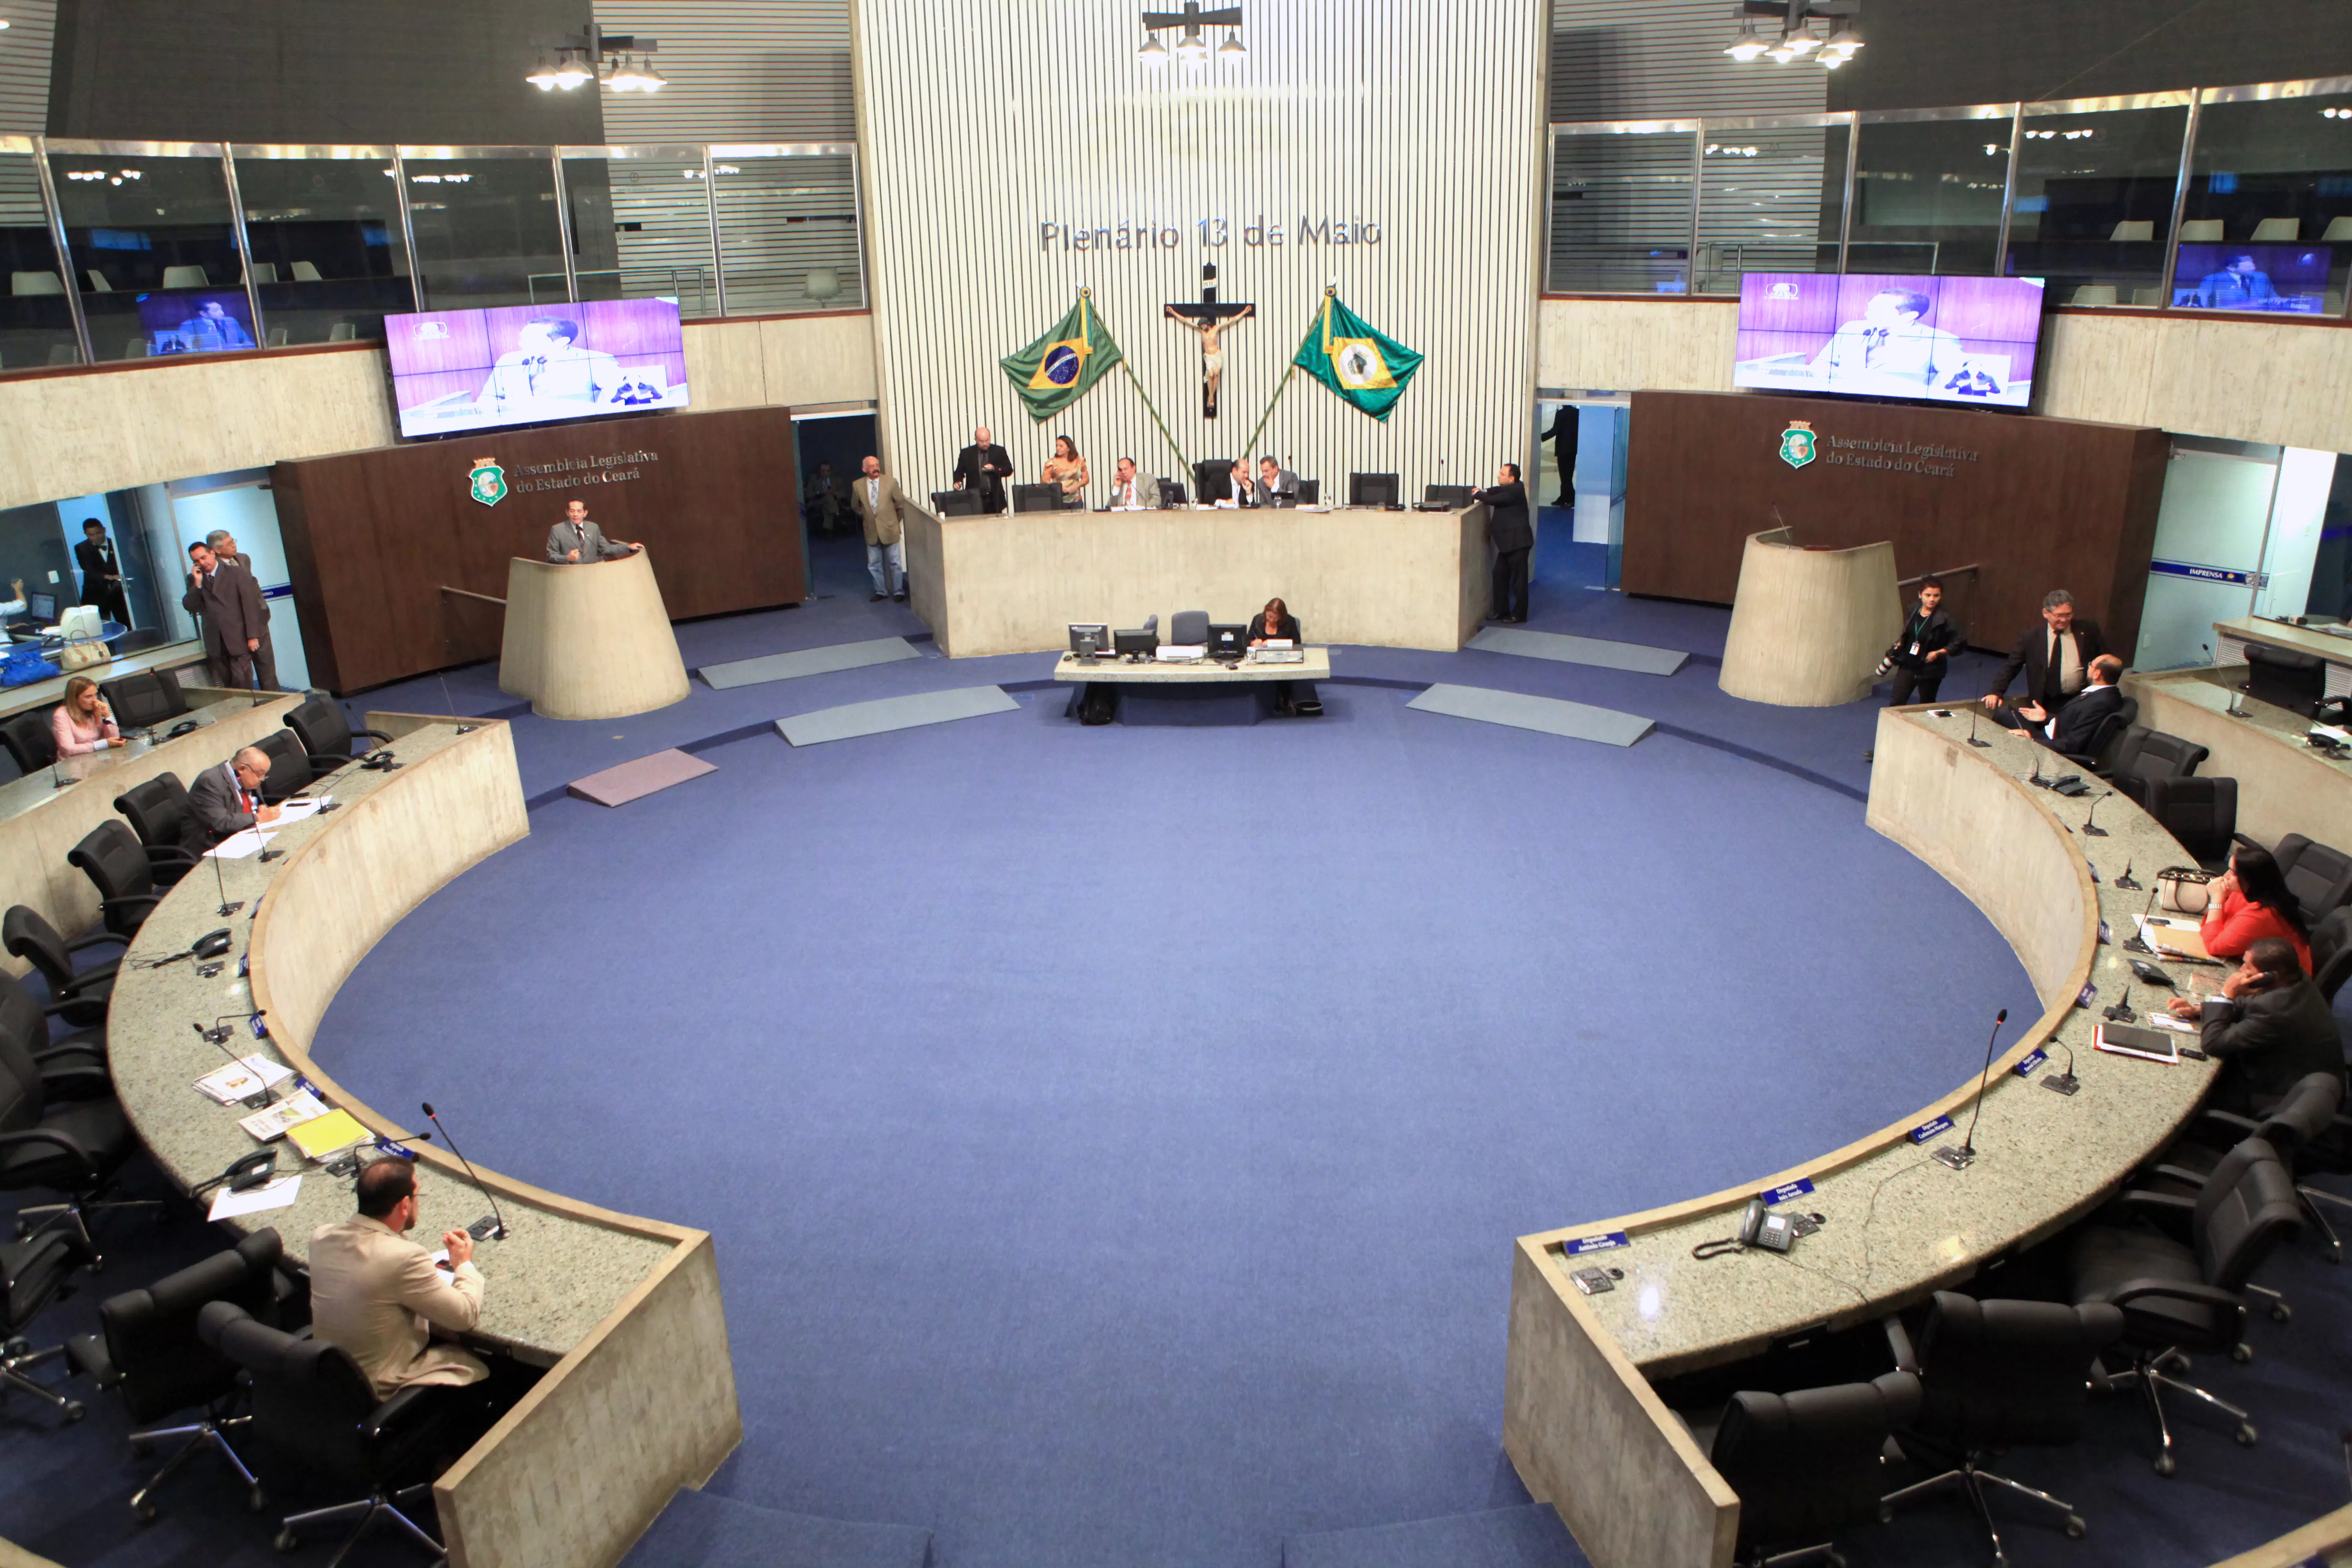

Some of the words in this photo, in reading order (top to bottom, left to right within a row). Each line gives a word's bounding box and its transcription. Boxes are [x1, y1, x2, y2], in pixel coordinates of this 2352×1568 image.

[1041, 217, 1179, 251] Plenário
[1196, 217, 1228, 247] 13
[1244, 214, 1284, 246] de
[1299, 214, 1381, 245] Maio
[1827, 435, 1903, 454] Assembleia
[1906, 441, 1978, 462] Legislativa
[513, 457, 588, 477] Assembleia
[590, 450, 658, 469] Legislativa
[1826, 451, 1843, 464] do
[1846, 454, 1891, 469] Estado
[1894, 458, 1912, 472] do
[1914, 461, 1955, 477] Ceará
[517, 481, 533, 493] do
[536, 474, 580, 491] Estado
[583, 472, 600, 485] do
[602, 467, 640, 482] Ceará
[2190, 568, 2223, 579] IMPRENSA
